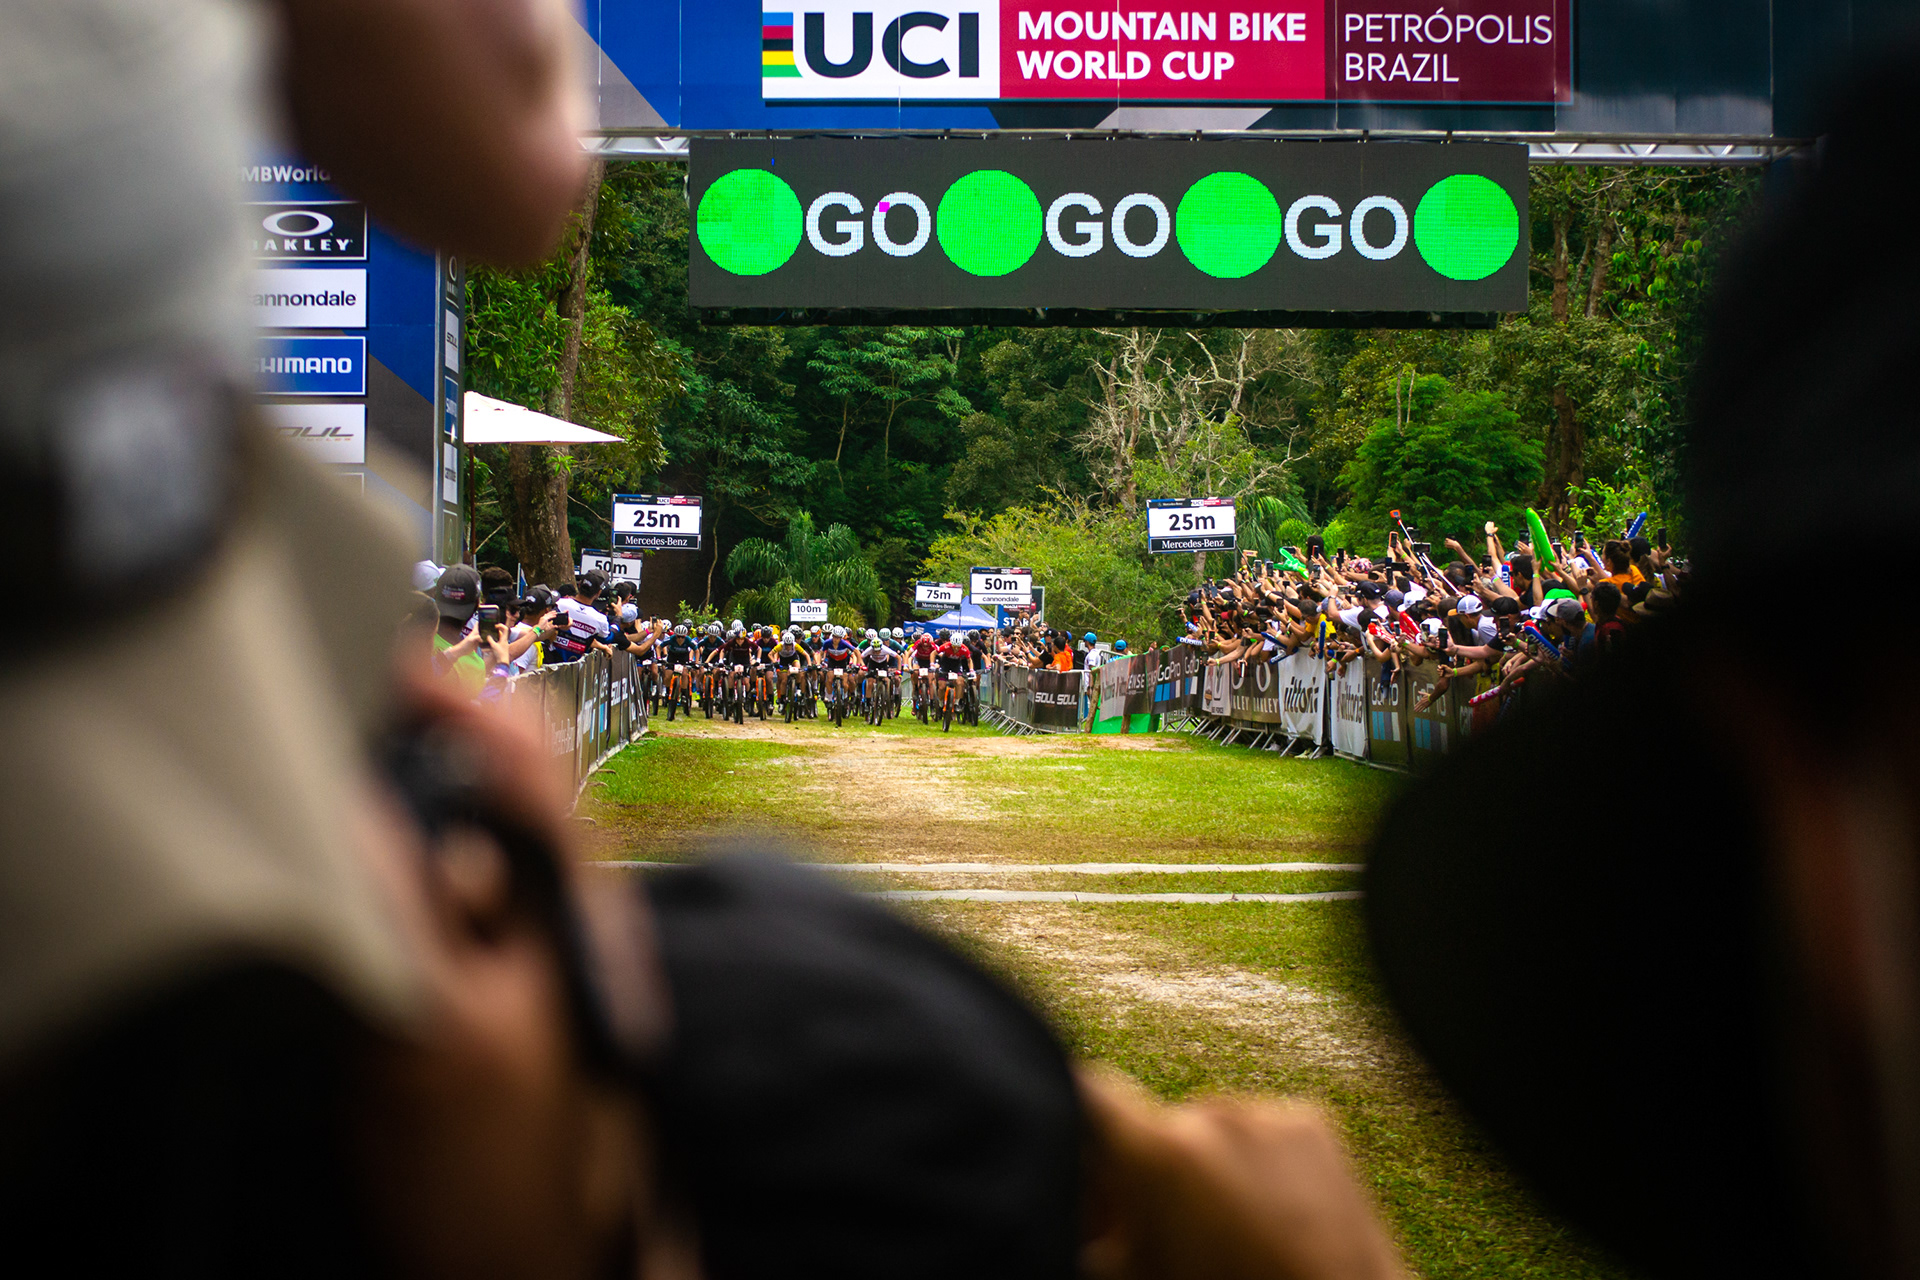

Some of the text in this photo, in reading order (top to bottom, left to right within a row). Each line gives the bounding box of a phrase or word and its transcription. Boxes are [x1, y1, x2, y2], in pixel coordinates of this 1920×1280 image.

[1018, 11, 1306, 42] MOUNTAIN BIKE
[1345, 7, 1552, 44] PETRÓPOLIS
[803, 12, 980, 79] UCI
[1016, 50, 1235, 81] WORLD CUP
[1345, 53, 1460, 82] BRAZIL
[806, 192, 1409, 260] GO GO GO
[251, 239, 350, 251] AKLEY
[633, 510, 680, 528] 25m
[1168, 513, 1216, 531] 25m
[625, 535, 688, 546] Mercedes-Benz
[1161, 539, 1225, 549] Mercedes-Benz
[984, 577, 1018, 591] 50m
[926, 589, 951, 600] 75m
[796, 605, 822, 613] 100m
[921, 602, 956, 610] Mercedes-Benz
[1157, 661, 1181, 682] GoPro
[1035, 692, 1078, 706] SOUL SOUL
